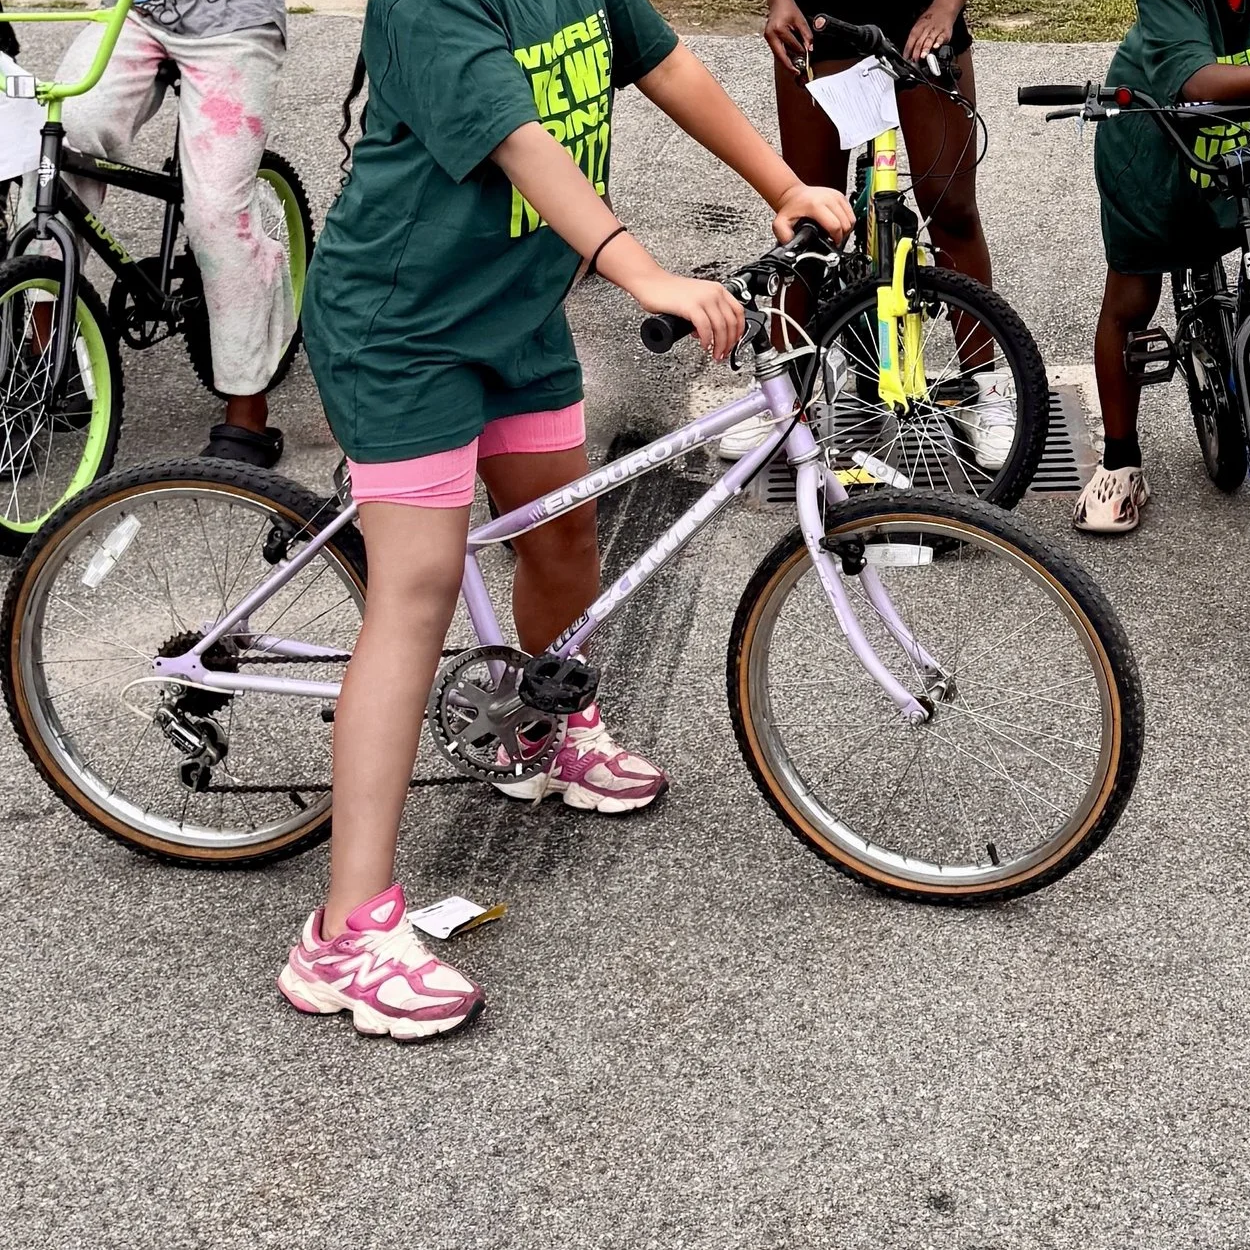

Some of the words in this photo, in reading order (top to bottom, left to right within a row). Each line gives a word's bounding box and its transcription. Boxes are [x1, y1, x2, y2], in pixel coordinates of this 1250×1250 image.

[564, 38, 611, 104] WE
[544, 441, 673, 515] ENDURO
[589, 479, 732, 622] SCHWINN
